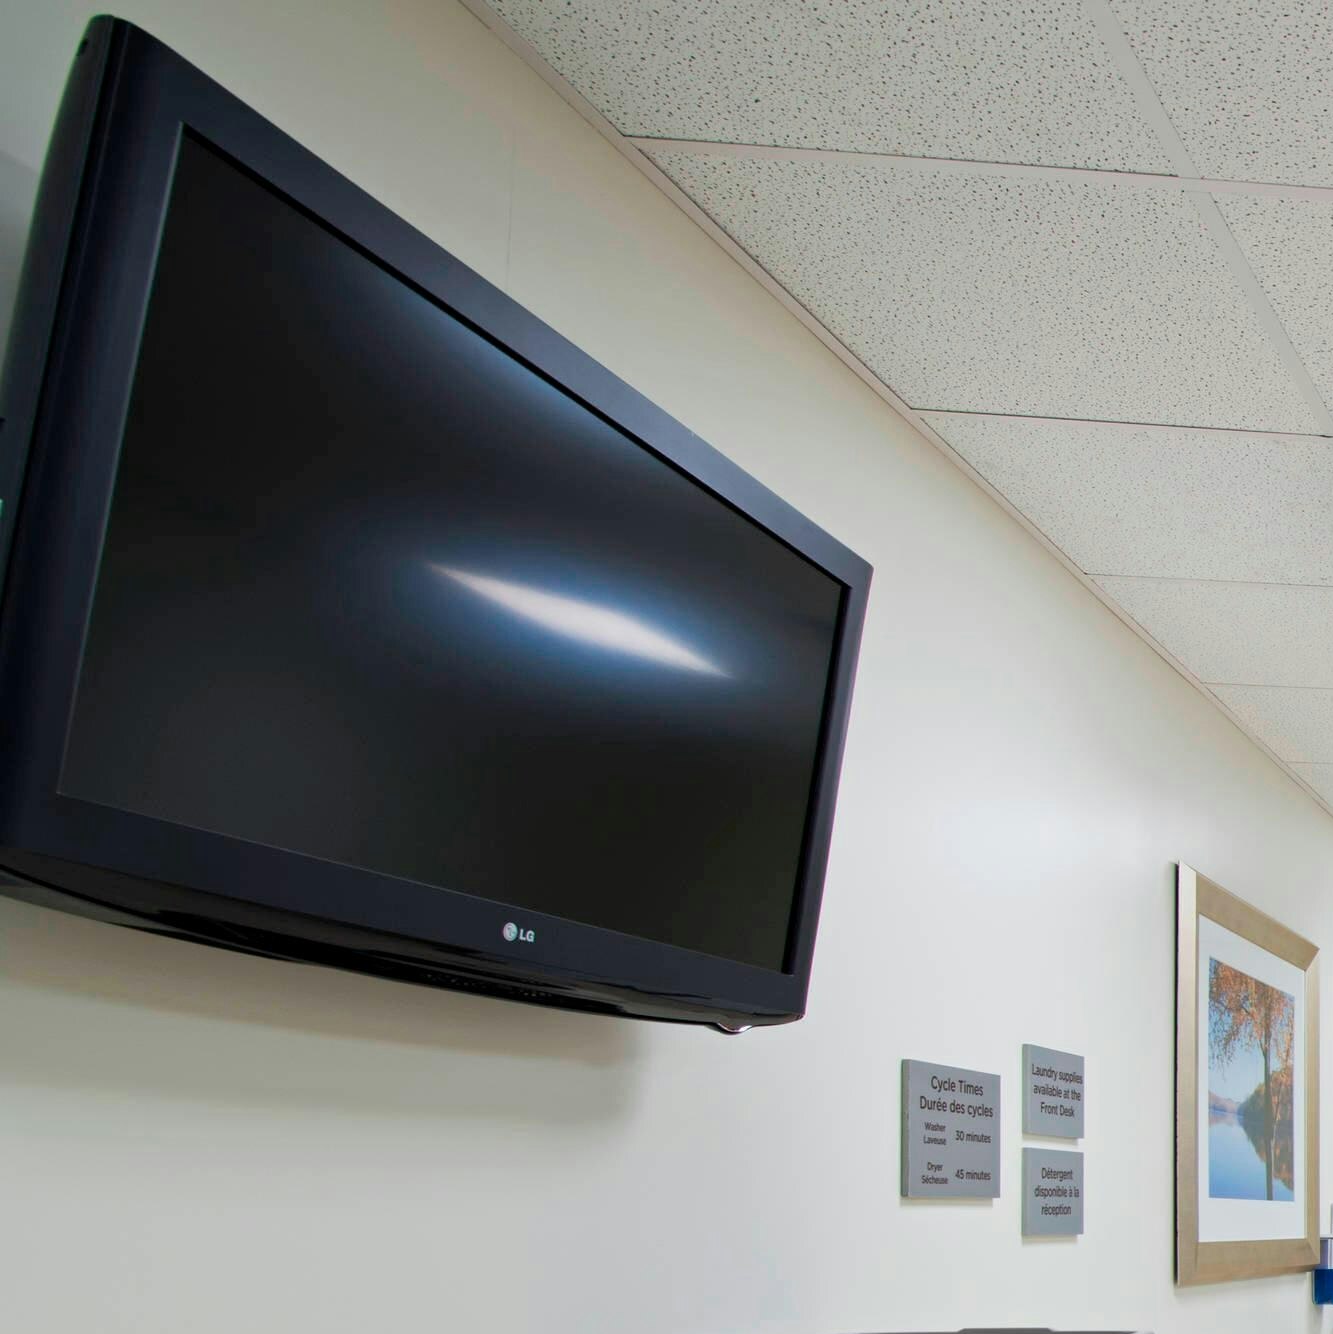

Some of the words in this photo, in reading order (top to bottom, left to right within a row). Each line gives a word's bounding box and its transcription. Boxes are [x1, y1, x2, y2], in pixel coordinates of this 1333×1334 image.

[1031, 1063, 1058, 1081] Laundry
[1058, 1071, 1083, 1085] supplies
[931, 1075, 956, 1093] Cycle
[958, 1079, 984, 1097] Times
[1033, 1084, 1063, 1099] available
[1063, 1089, 1070, 1099] at
[1071, 1088, 1081, 1101] the
[919, 1095, 948, 1113] Durée
[949, 1100, 966, 1115] des
[967, 1103, 994, 1118] cycles
[1040, 1101, 1058, 1116] Front
[1059, 1104, 1075, 1117] Desk
[924, 1121, 946, 1133] Washer
[923, 1134, 947, 1146] Laveuse
[955, 1129, 965, 1141] 30
[965, 1131, 992, 1144] minutes
[927, 1161, 943, 1173] Dryer
[955, 1168, 965, 1180] 45
[965, 1170, 991, 1181] minutes
[1041, 1167, 1073, 1182] Détergent
[921, 1174, 949, 1185] Sécheuse
[1033, 1184, 1068, 1199] disponible
[1040, 1203, 1072, 1217] réception
